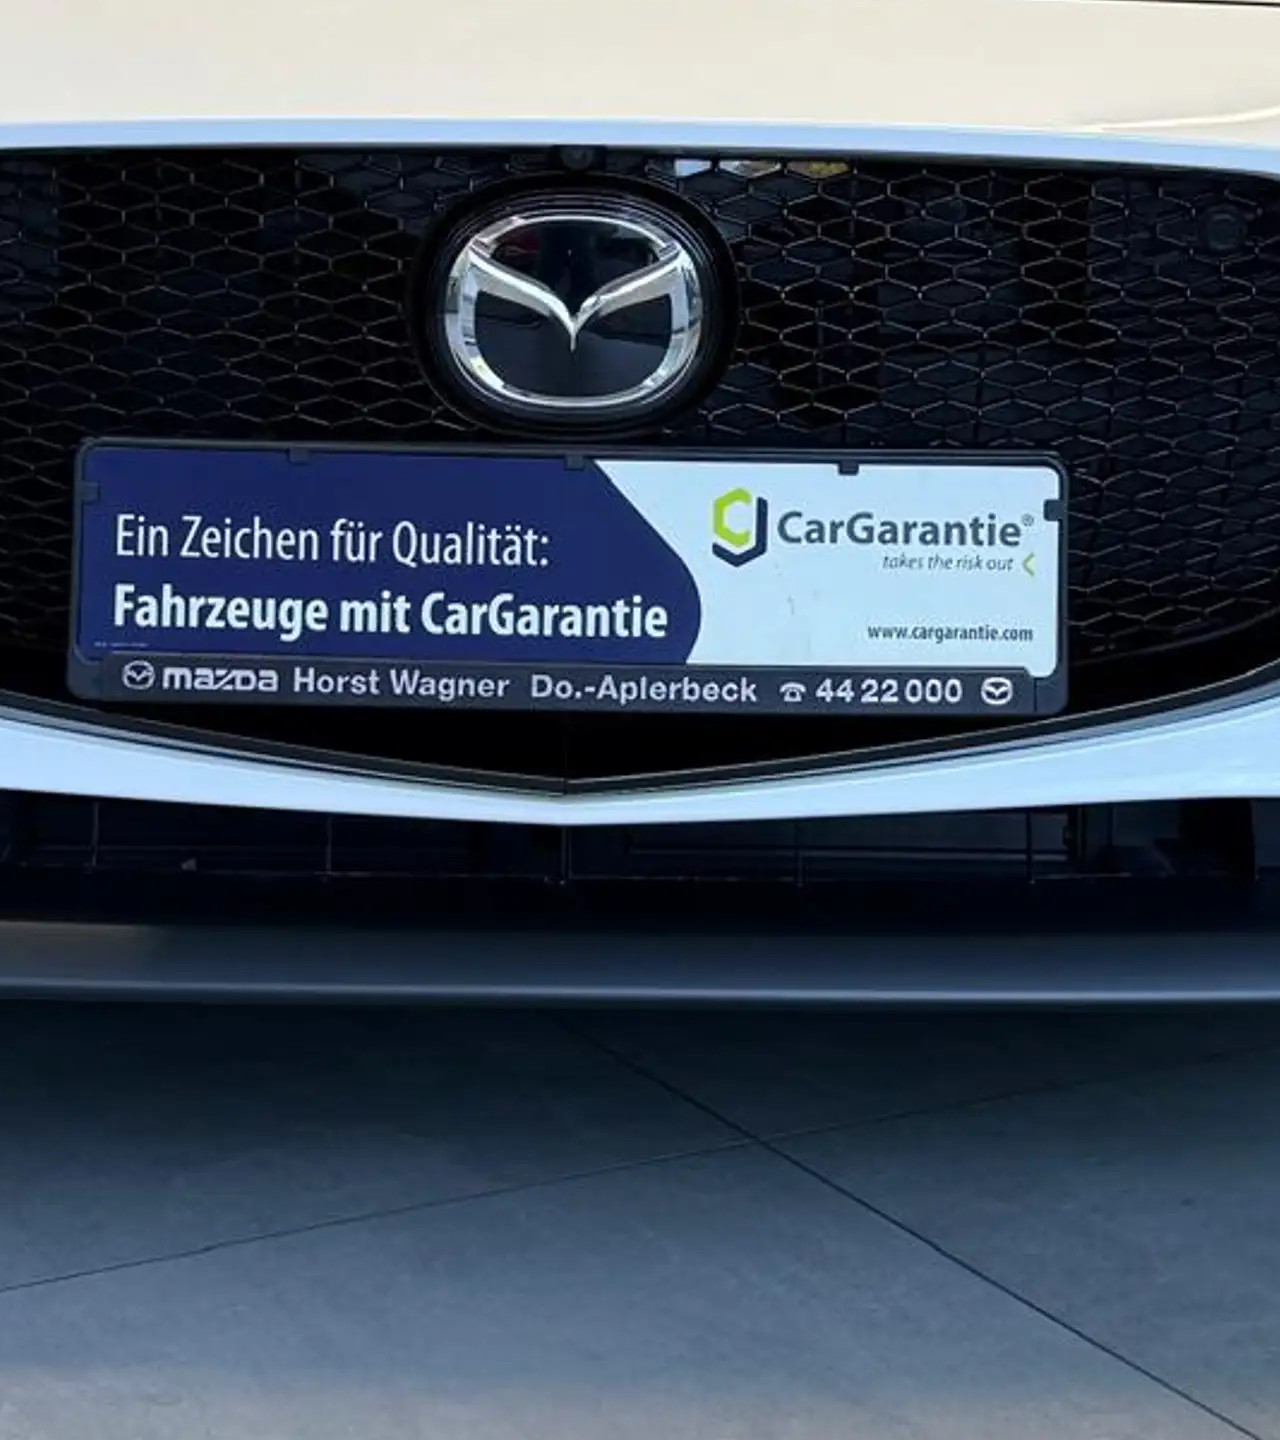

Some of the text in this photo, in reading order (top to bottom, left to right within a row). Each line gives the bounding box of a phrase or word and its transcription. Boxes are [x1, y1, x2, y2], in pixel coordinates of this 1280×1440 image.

[116, 513, 550, 568] Ein Zeichen für Qualität:
[882, 551, 1014, 571] takes the risk out
[113, 582, 669, 641] Fahrzeuge mit CarGarantie
[867, 624, 1034, 645] www.cargarantie.com
[293, 667, 380, 695] Horst
[390, 670, 510, 702] Wagner
[531, 674, 757, 709] Do.-Aplerbeck
